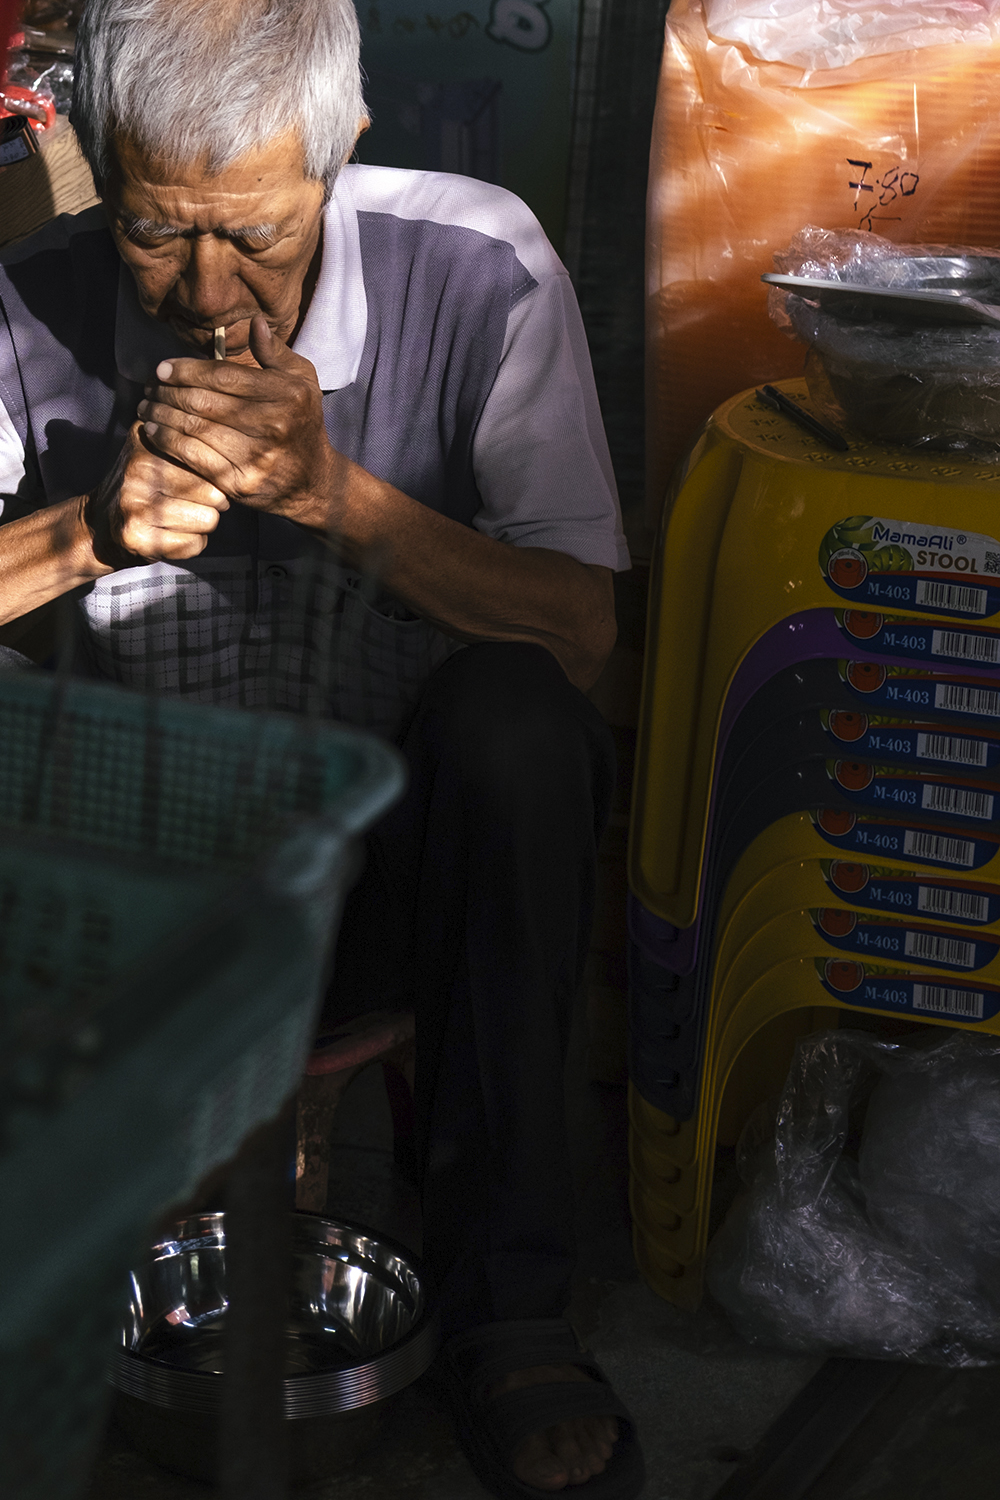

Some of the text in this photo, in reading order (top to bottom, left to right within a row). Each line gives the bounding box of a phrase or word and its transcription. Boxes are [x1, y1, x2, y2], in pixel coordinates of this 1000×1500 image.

[846, 158, 920, 211] 7.80
[873, 526, 953, 551] MamaAli
[917, 550, 978, 573] STOOL
[867, 582, 910, 600] M-403
[883, 632, 927, 651] M-403
[886, 686, 930, 704] M-403
[869, 735, 911, 753] M-403
[873, 785, 917, 804] M-403
[855, 830, 899, 849] M-403
[869, 887, 913, 906] M-403
[857, 932, 900, 951] M-403
[864, 985, 908, 1004] M-403
